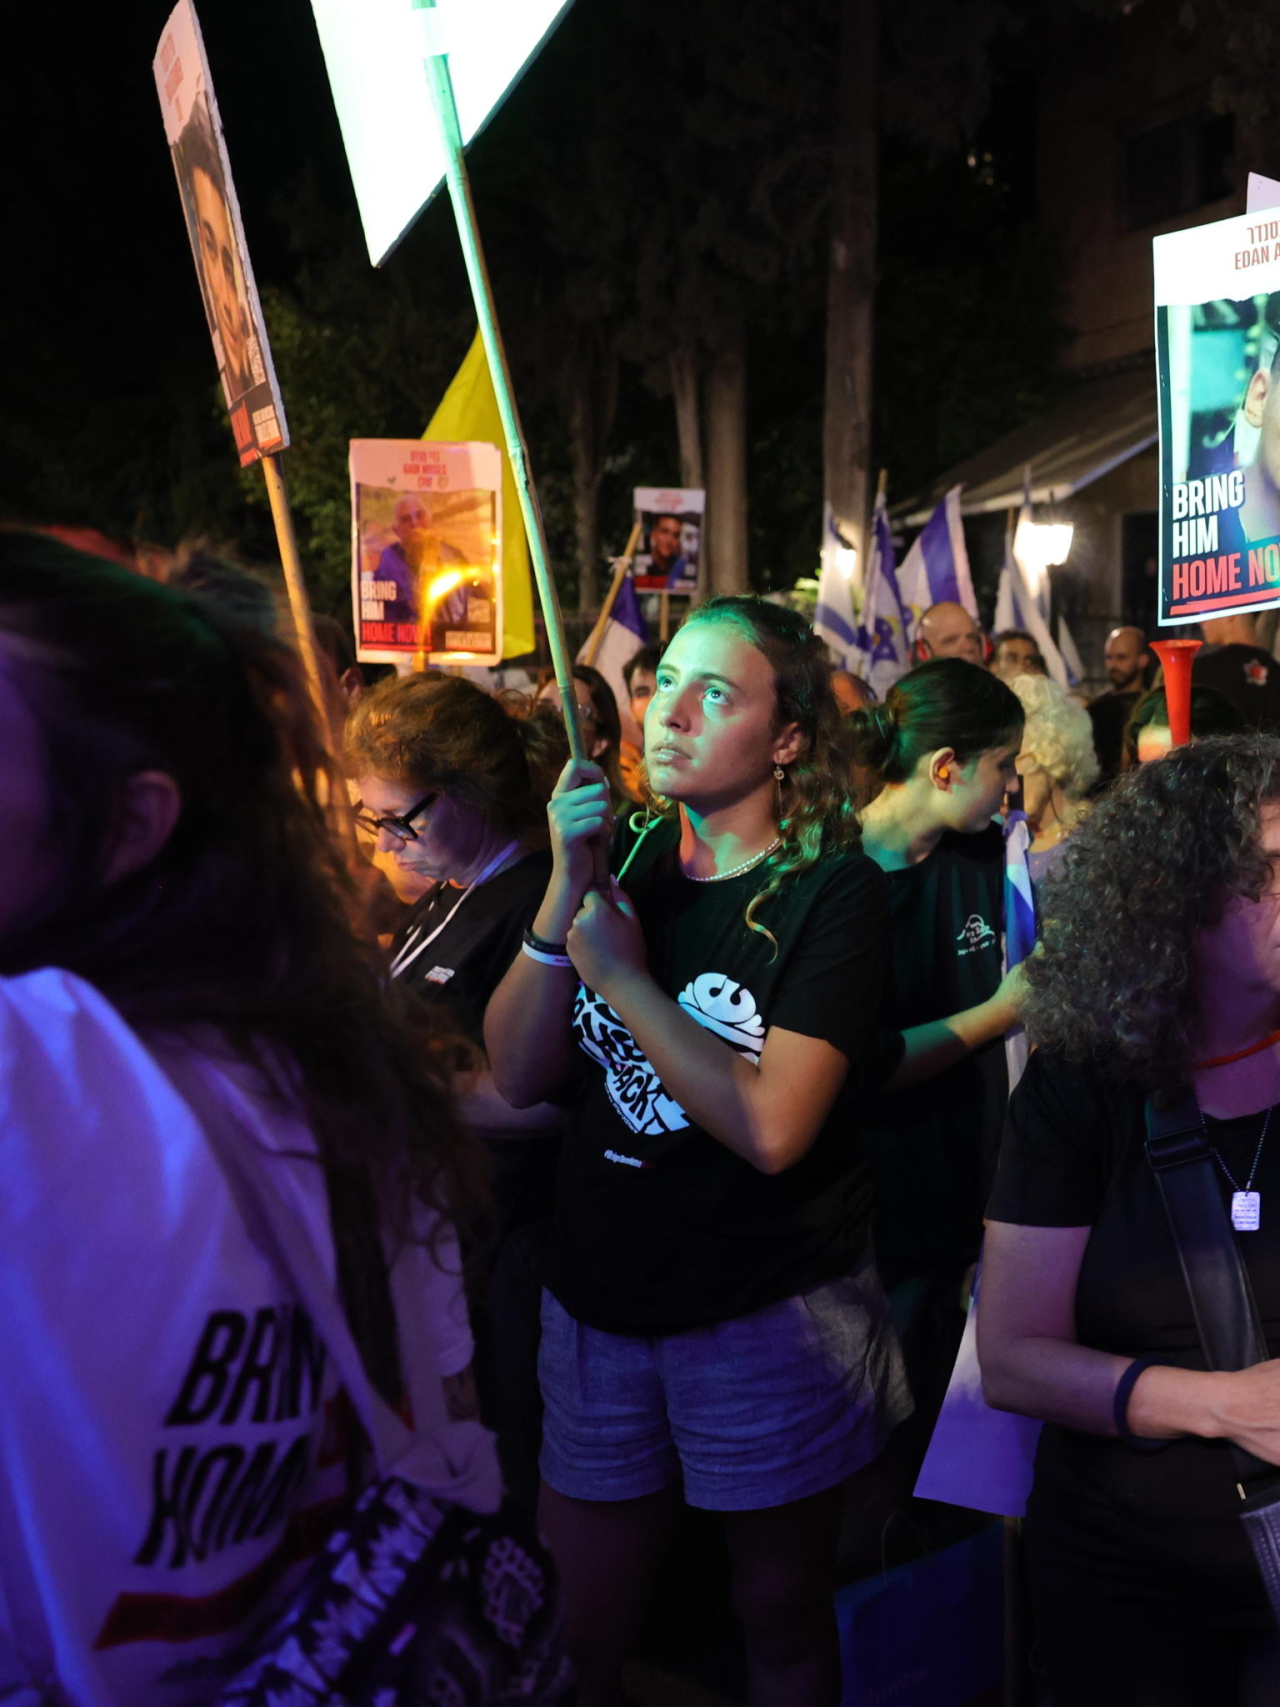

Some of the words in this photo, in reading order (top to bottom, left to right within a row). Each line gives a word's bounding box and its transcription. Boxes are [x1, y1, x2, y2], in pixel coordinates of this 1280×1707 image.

[1235, 247, 1270, 270] EDAN
[1173, 471, 1244, 520] BRING
[1173, 515, 1219, 559] HIM
[360, 580, 397, 601] BRING
[1173, 553, 1242, 600] HOME
[361, 601, 385, 621] HIM
[362, 623, 396, 642] HOME
[134, 1435, 313, 1569] HOM
